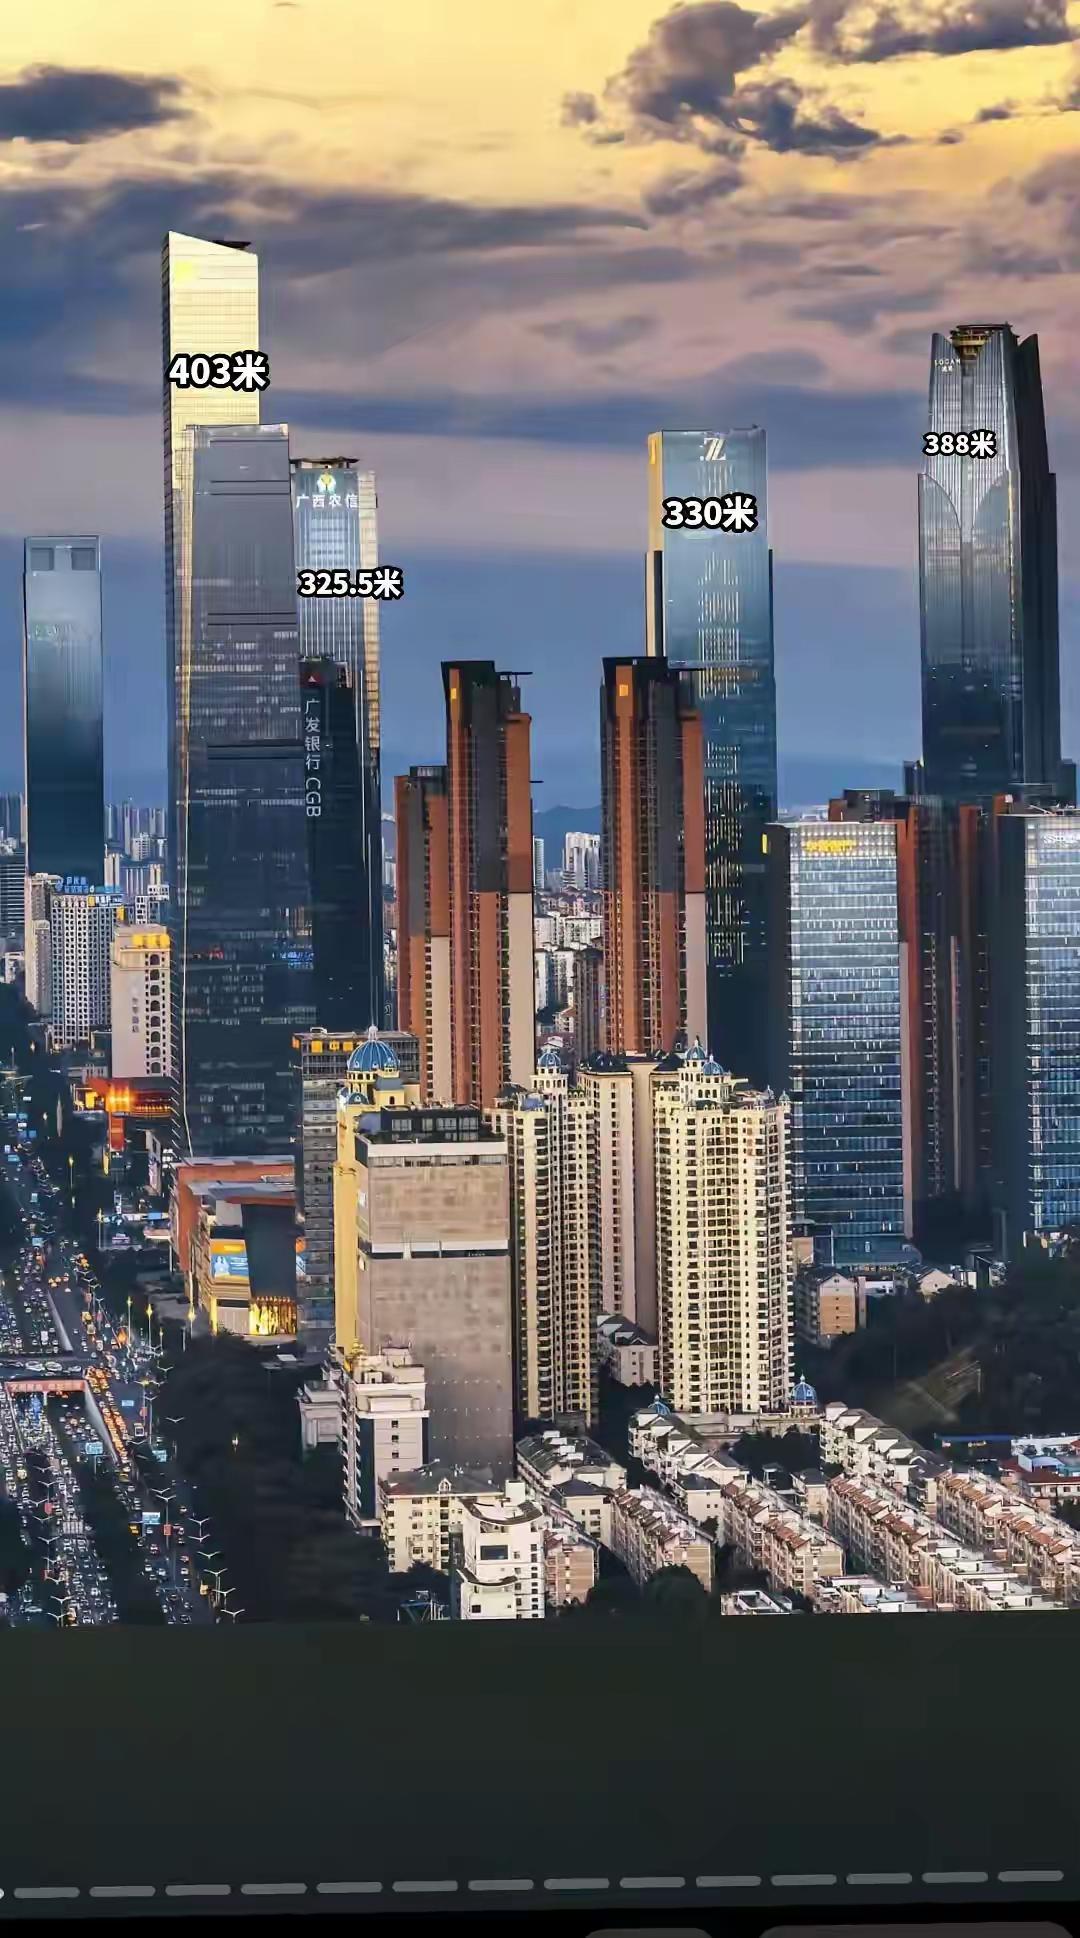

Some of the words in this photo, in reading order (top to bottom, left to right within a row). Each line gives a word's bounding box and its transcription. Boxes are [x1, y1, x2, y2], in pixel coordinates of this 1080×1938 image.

[295, 493, 359, 508] 广西农信
[304, 697, 321, 770] 广发银行
[305, 777, 322, 817] CGB
